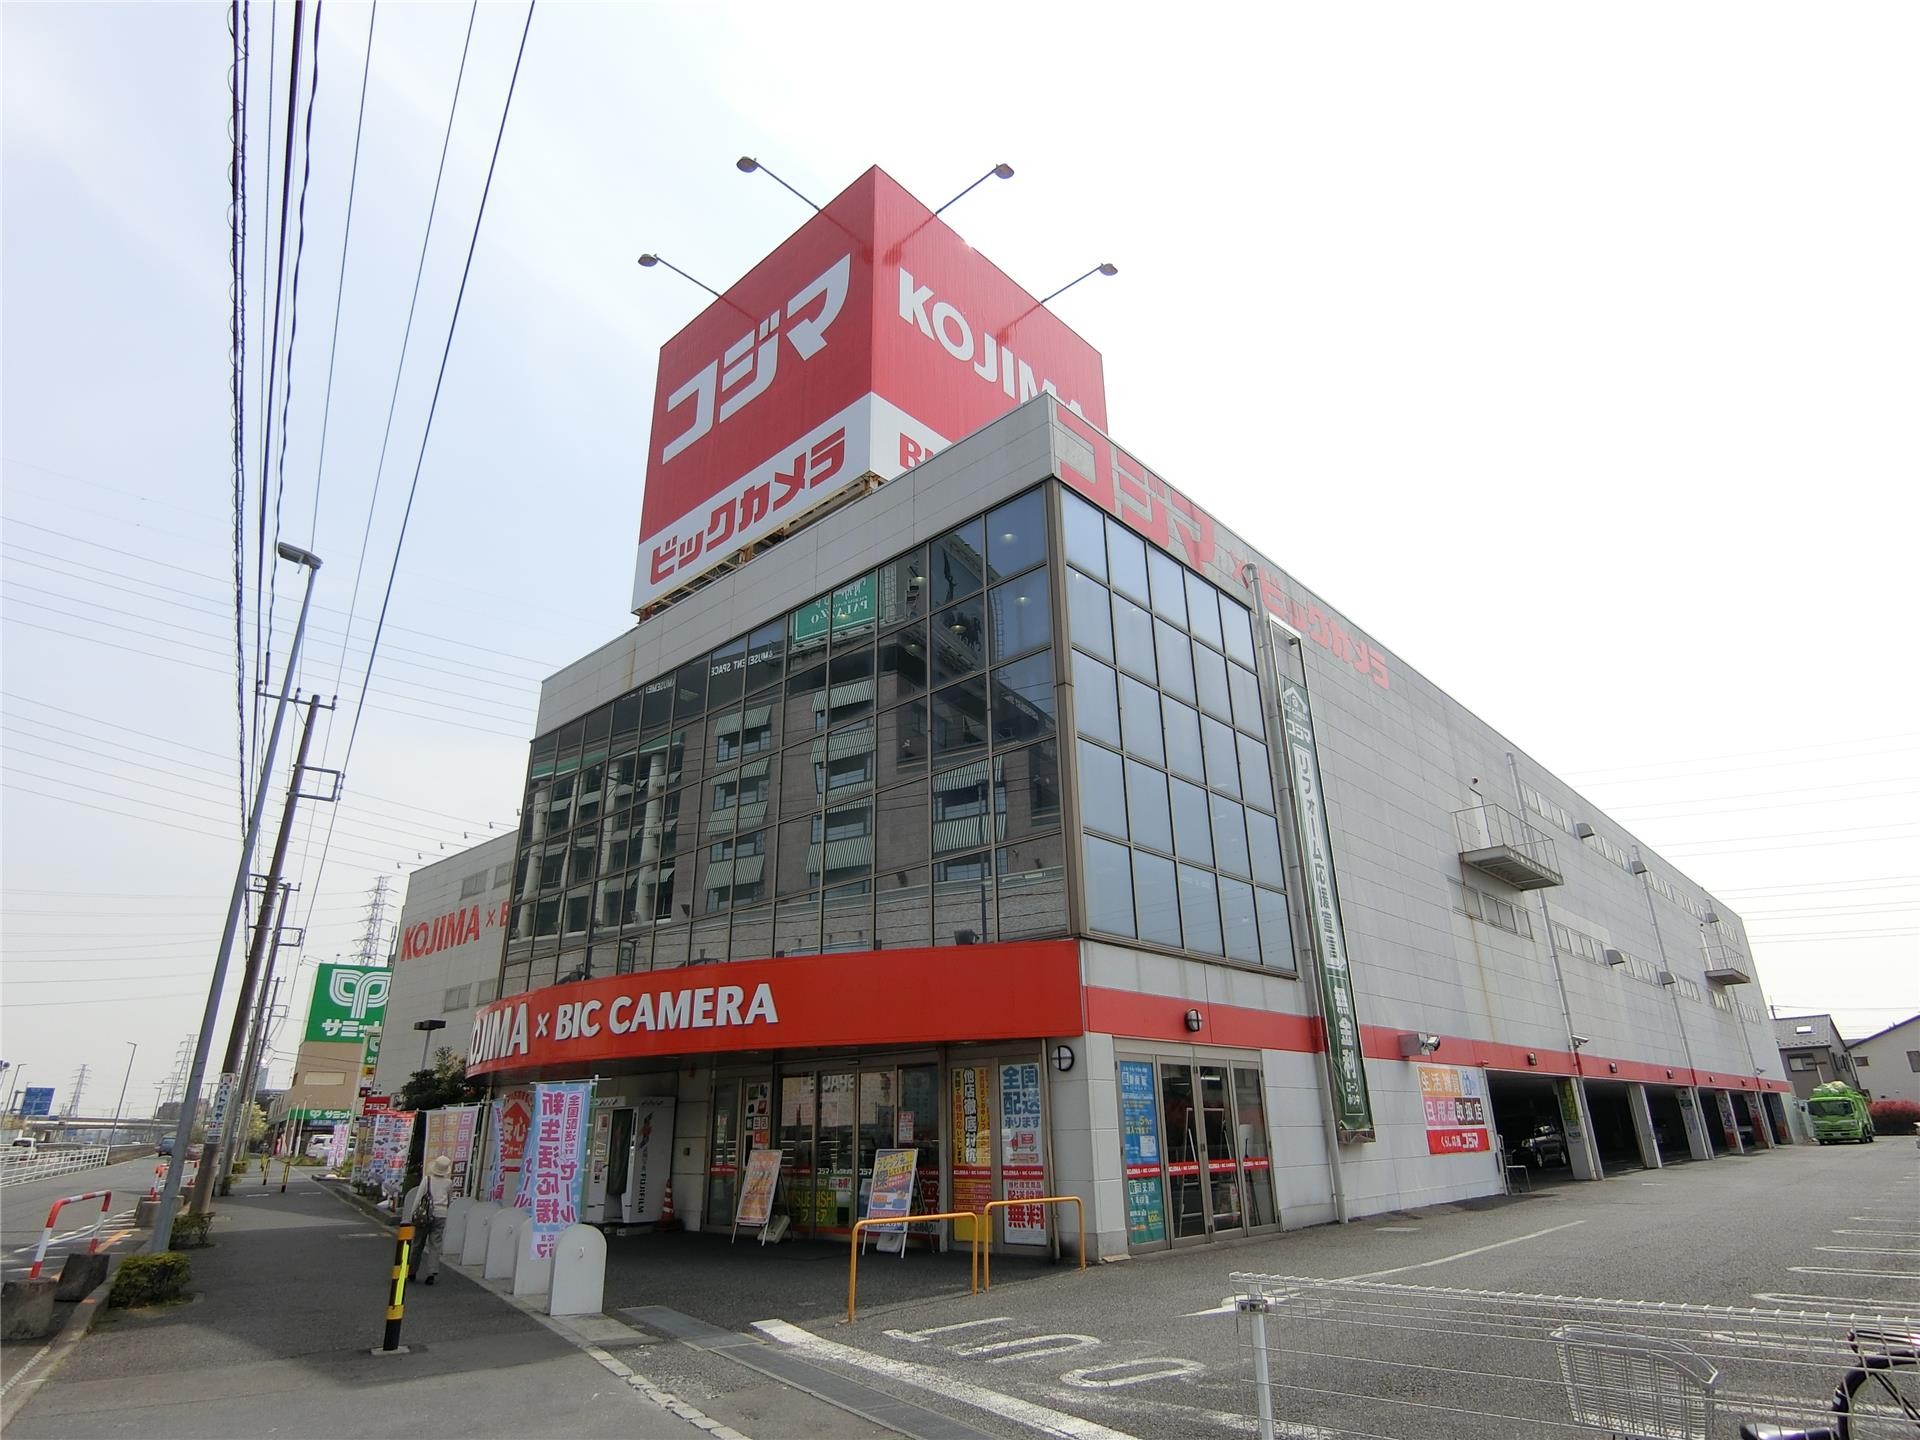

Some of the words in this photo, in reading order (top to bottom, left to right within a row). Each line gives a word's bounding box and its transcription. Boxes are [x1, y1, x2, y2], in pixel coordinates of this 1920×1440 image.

[662, 253, 851, 465] コジマ
[650, 426, 847, 585] ビックカメラ
[1056, 403, 1216, 574] コジマ
[1287, 718, 1312, 745] コジマ
[400, 903, 480, 962] KOJIMA
[466, 1002, 529, 1067] OJIMA
[555, 999, 603, 1041] BIC
[609, 983, 779, 1036] CAMERA
[1002, 1065, 1039, 1090] 全国
[324, 1110, 352, 1120] サミット
[962, 1068, 978, 1164] 他店徹底対抗
[1003, 1091, 1041, 1116] 配送
[1004, 1116, 1040, 1129] 承ります
[1007, 1203, 1045, 1230] 無料
